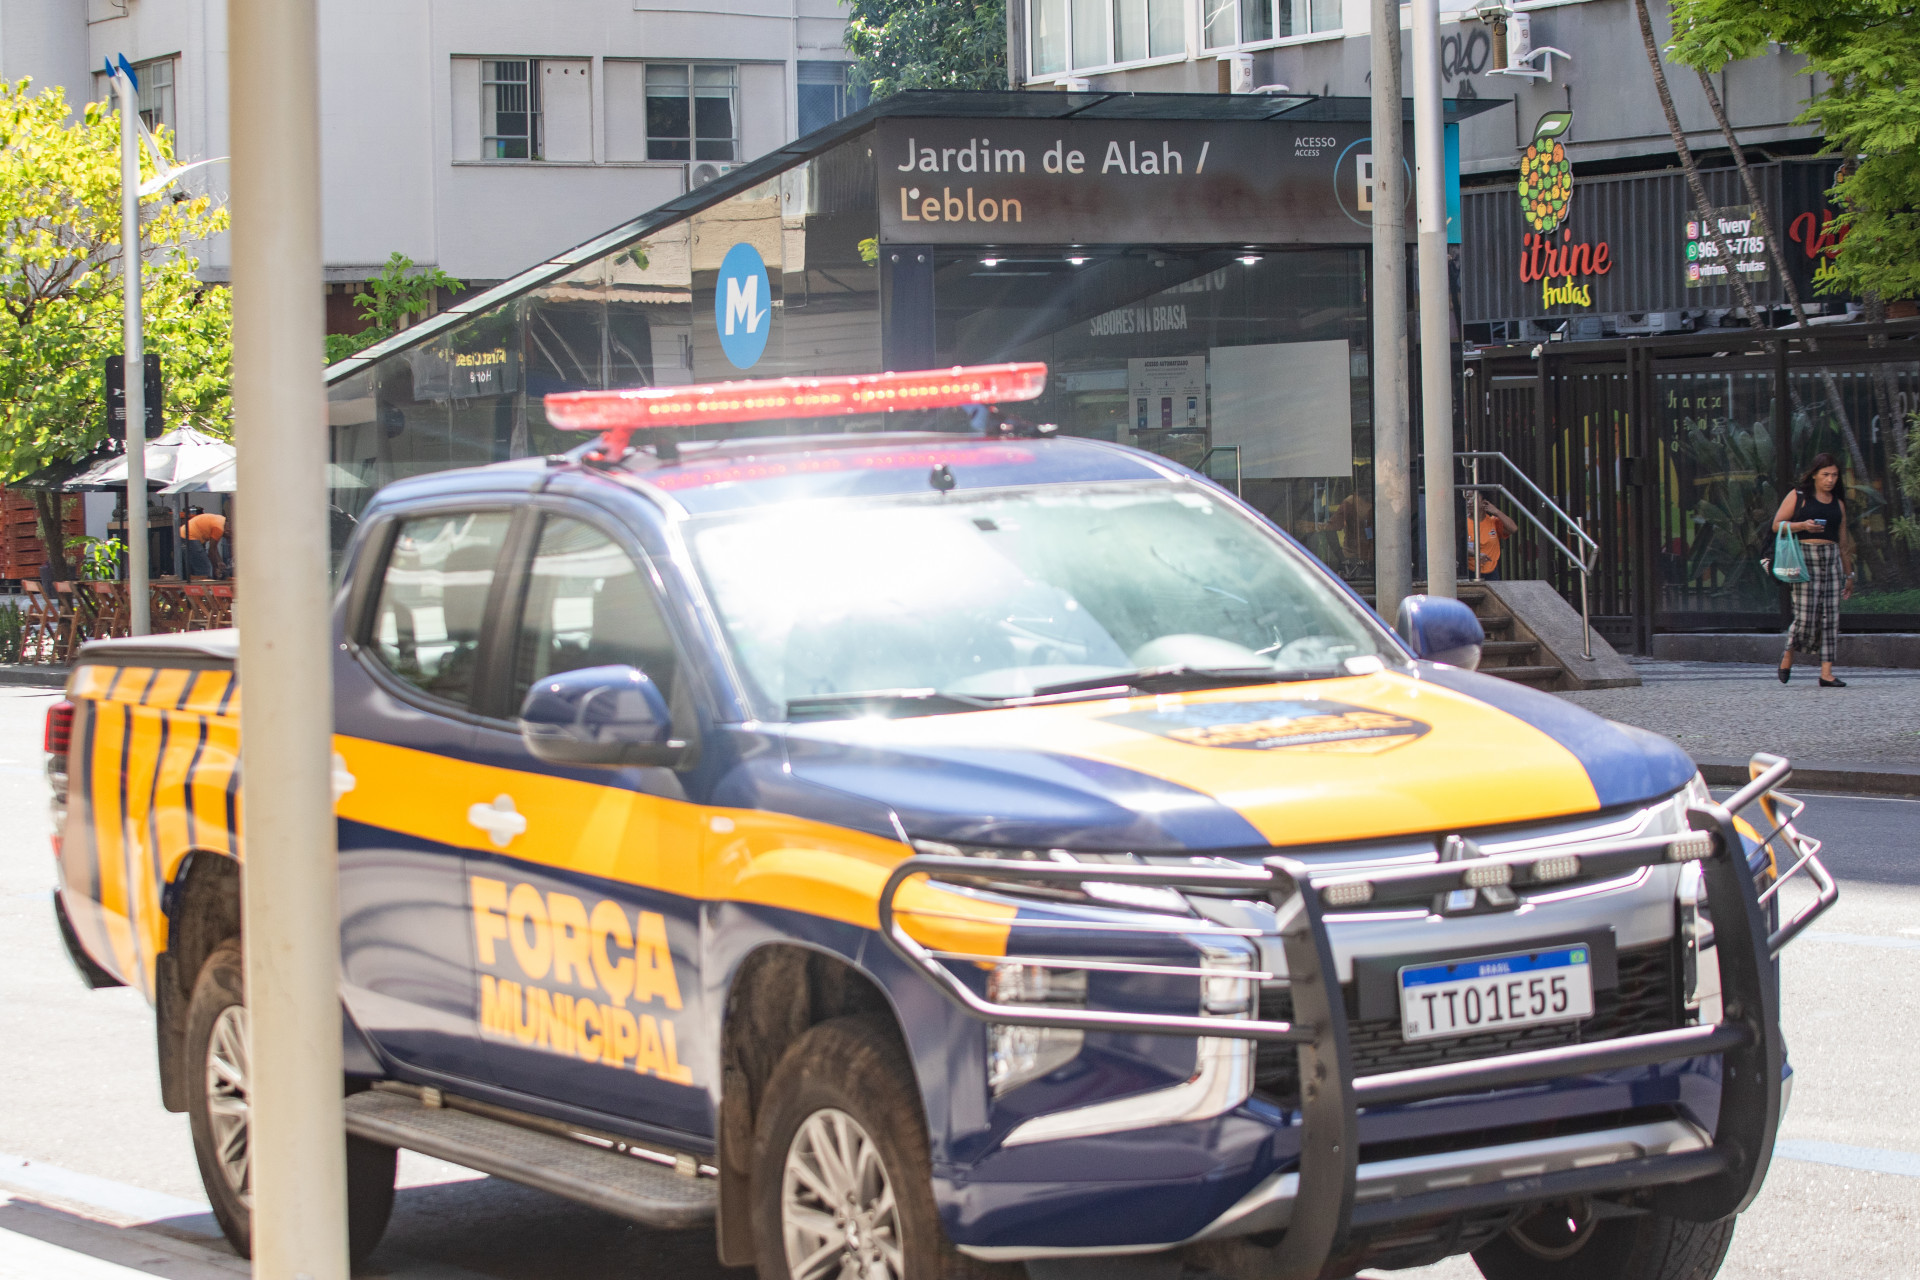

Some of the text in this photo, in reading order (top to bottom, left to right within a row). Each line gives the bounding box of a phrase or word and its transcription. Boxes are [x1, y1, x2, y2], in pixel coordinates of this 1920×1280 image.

[898, 138, 1210, 175] Jardim de Alah /
[1294, 137, 1336, 147] ACESSO
[1294, 149, 1320, 157] ACCESS
[900, 187, 1022, 222] Leblon
[1520, 228, 1612, 283] itrine
[725, 274, 767, 336] M
[1542, 275, 1591, 310] frutas
[1091, 308, 1135, 336] SABORES
[1153, 304, 1188, 332] BRASA
[471, 876, 684, 1010] FORÇA
[1479, 962, 1510, 977] BRASIL
[480, 974, 693, 1086] MUNICIPAL
